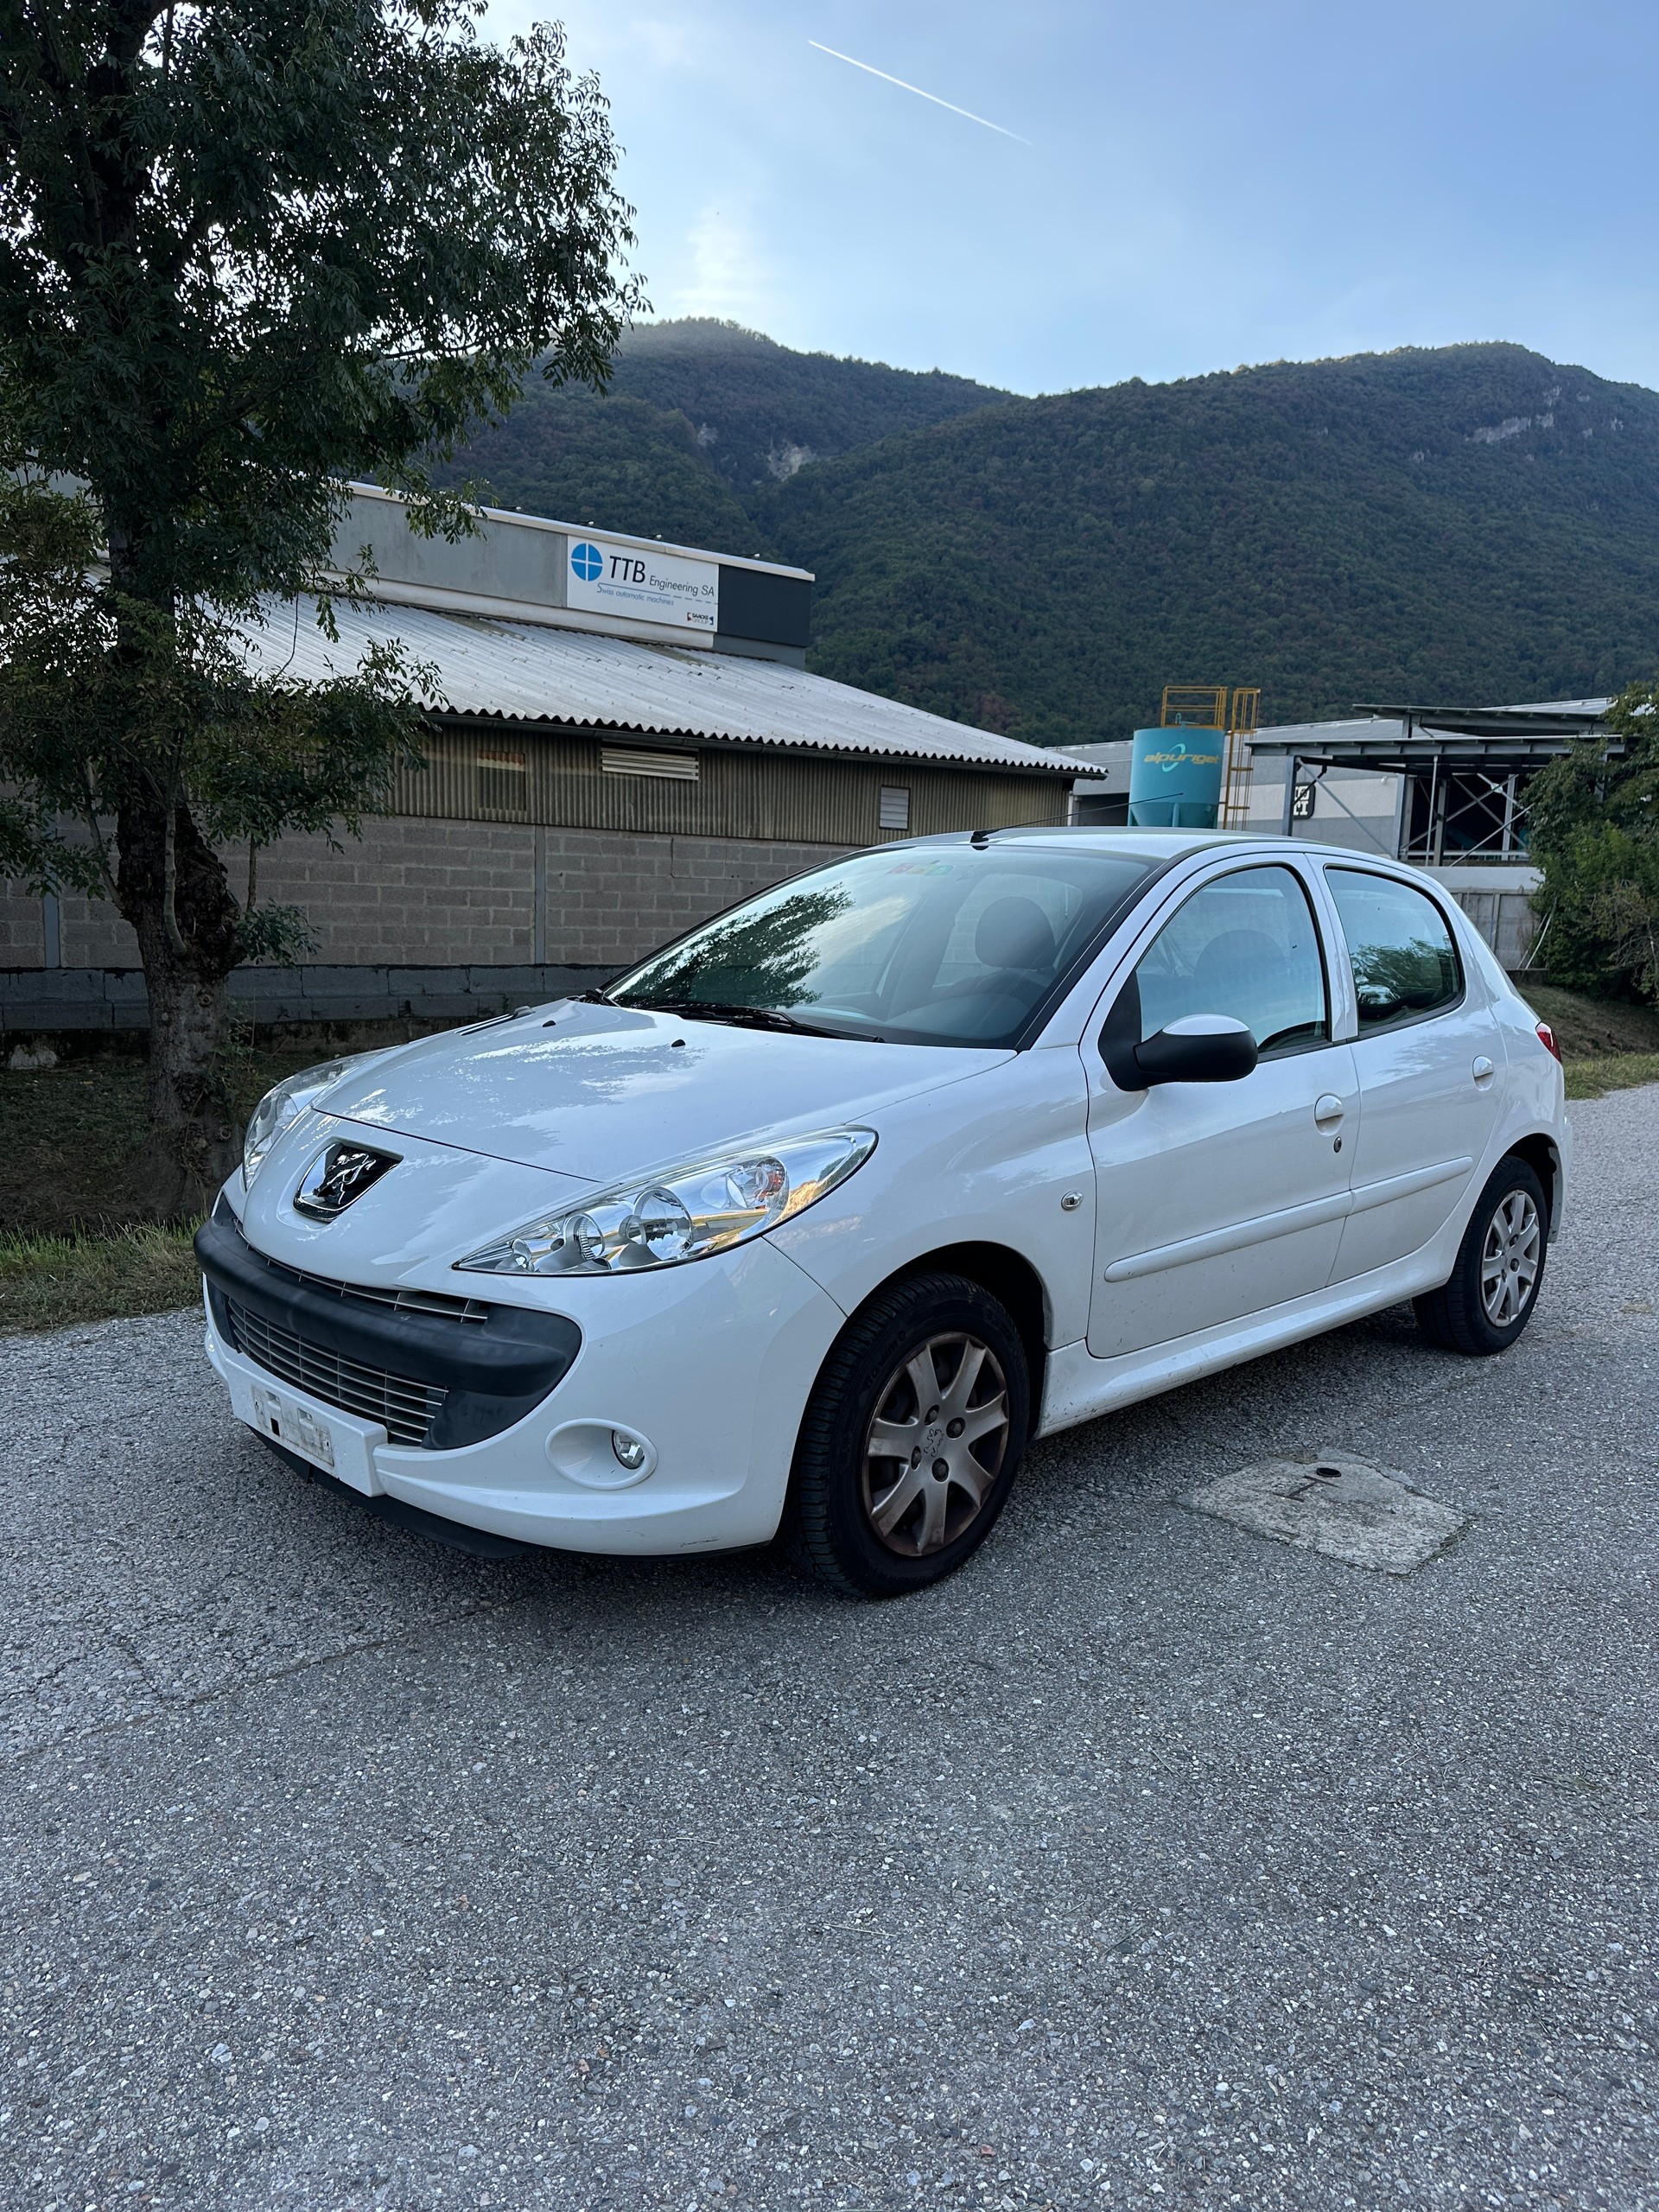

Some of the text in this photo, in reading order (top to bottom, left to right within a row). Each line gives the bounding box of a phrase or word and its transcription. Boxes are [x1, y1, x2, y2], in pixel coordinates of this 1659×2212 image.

[609, 555, 715, 597] TTB Engineering SA
[596, 582, 675, 607] Swiss automatic machines
